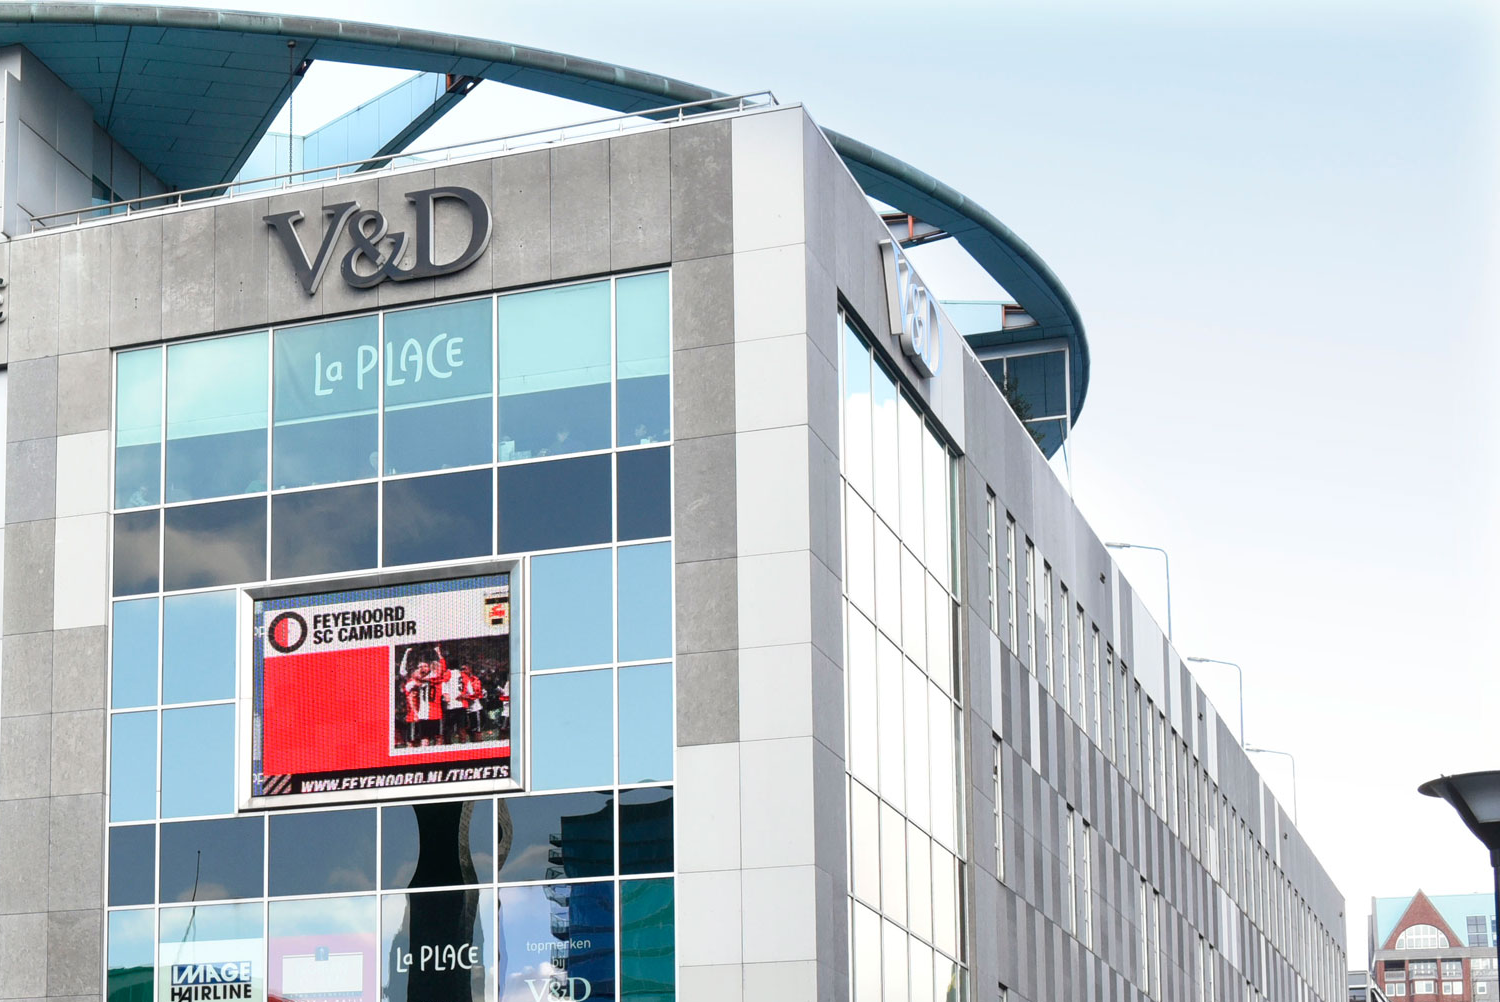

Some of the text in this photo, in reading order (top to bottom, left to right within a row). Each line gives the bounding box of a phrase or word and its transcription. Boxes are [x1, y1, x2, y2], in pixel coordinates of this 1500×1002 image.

[263, 186, 493, 296] V&D
[314, 333, 464, 396] La PLACE
[313, 606, 405, 630] FEYENOORD
[313, 620, 417, 645] SC CAMBUUR
[526, 937, 591, 954] topmerken
[396, 943, 479, 973] La PLACE
[552, 955, 566, 971] bij
[172, 961, 251, 985] IMAGE
